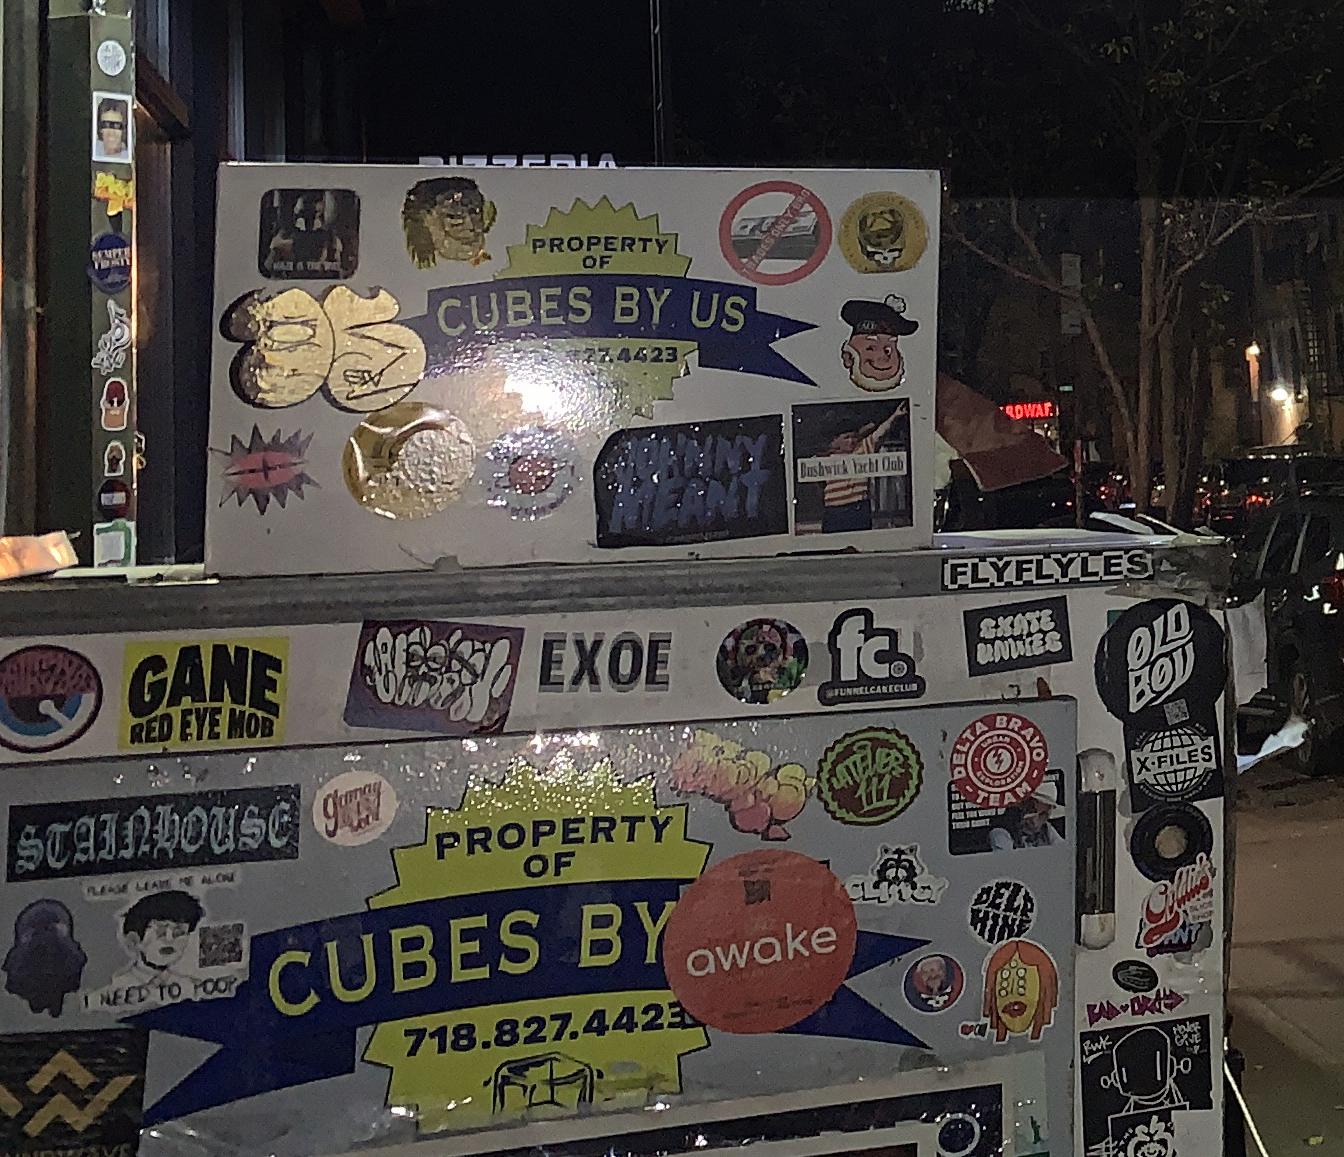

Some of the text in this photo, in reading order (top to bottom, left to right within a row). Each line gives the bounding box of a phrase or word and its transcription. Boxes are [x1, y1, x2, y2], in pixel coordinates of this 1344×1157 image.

[532, 236, 670, 255] PROPERTY
[582, 255, 612, 270] OF
[437, 286, 748, 337] CUBES BY US
[945, 550, 1152, 589] FLYFLYLES
[128, 644, 283, 719] GANE
[538, 631, 673, 693] EXOE
[129, 707, 275, 744] RED EYE MOB
[952, 715, 1045, 779] DELTA BRAVO
[976, 781, 1032, 807] TEAM
[15, 802, 292, 874] STAINHOUSE
[435, 816, 674, 860] PROPERTY
[523, 851, 576, 878] OF
[268, 900, 677, 1016] CUBES BY
[686, 923, 837, 977] awake
[100, 985, 150, 1007] NEED
[158, 982, 182, 1001] TO
[403, 1002, 687, 1058] 718.827.4423
